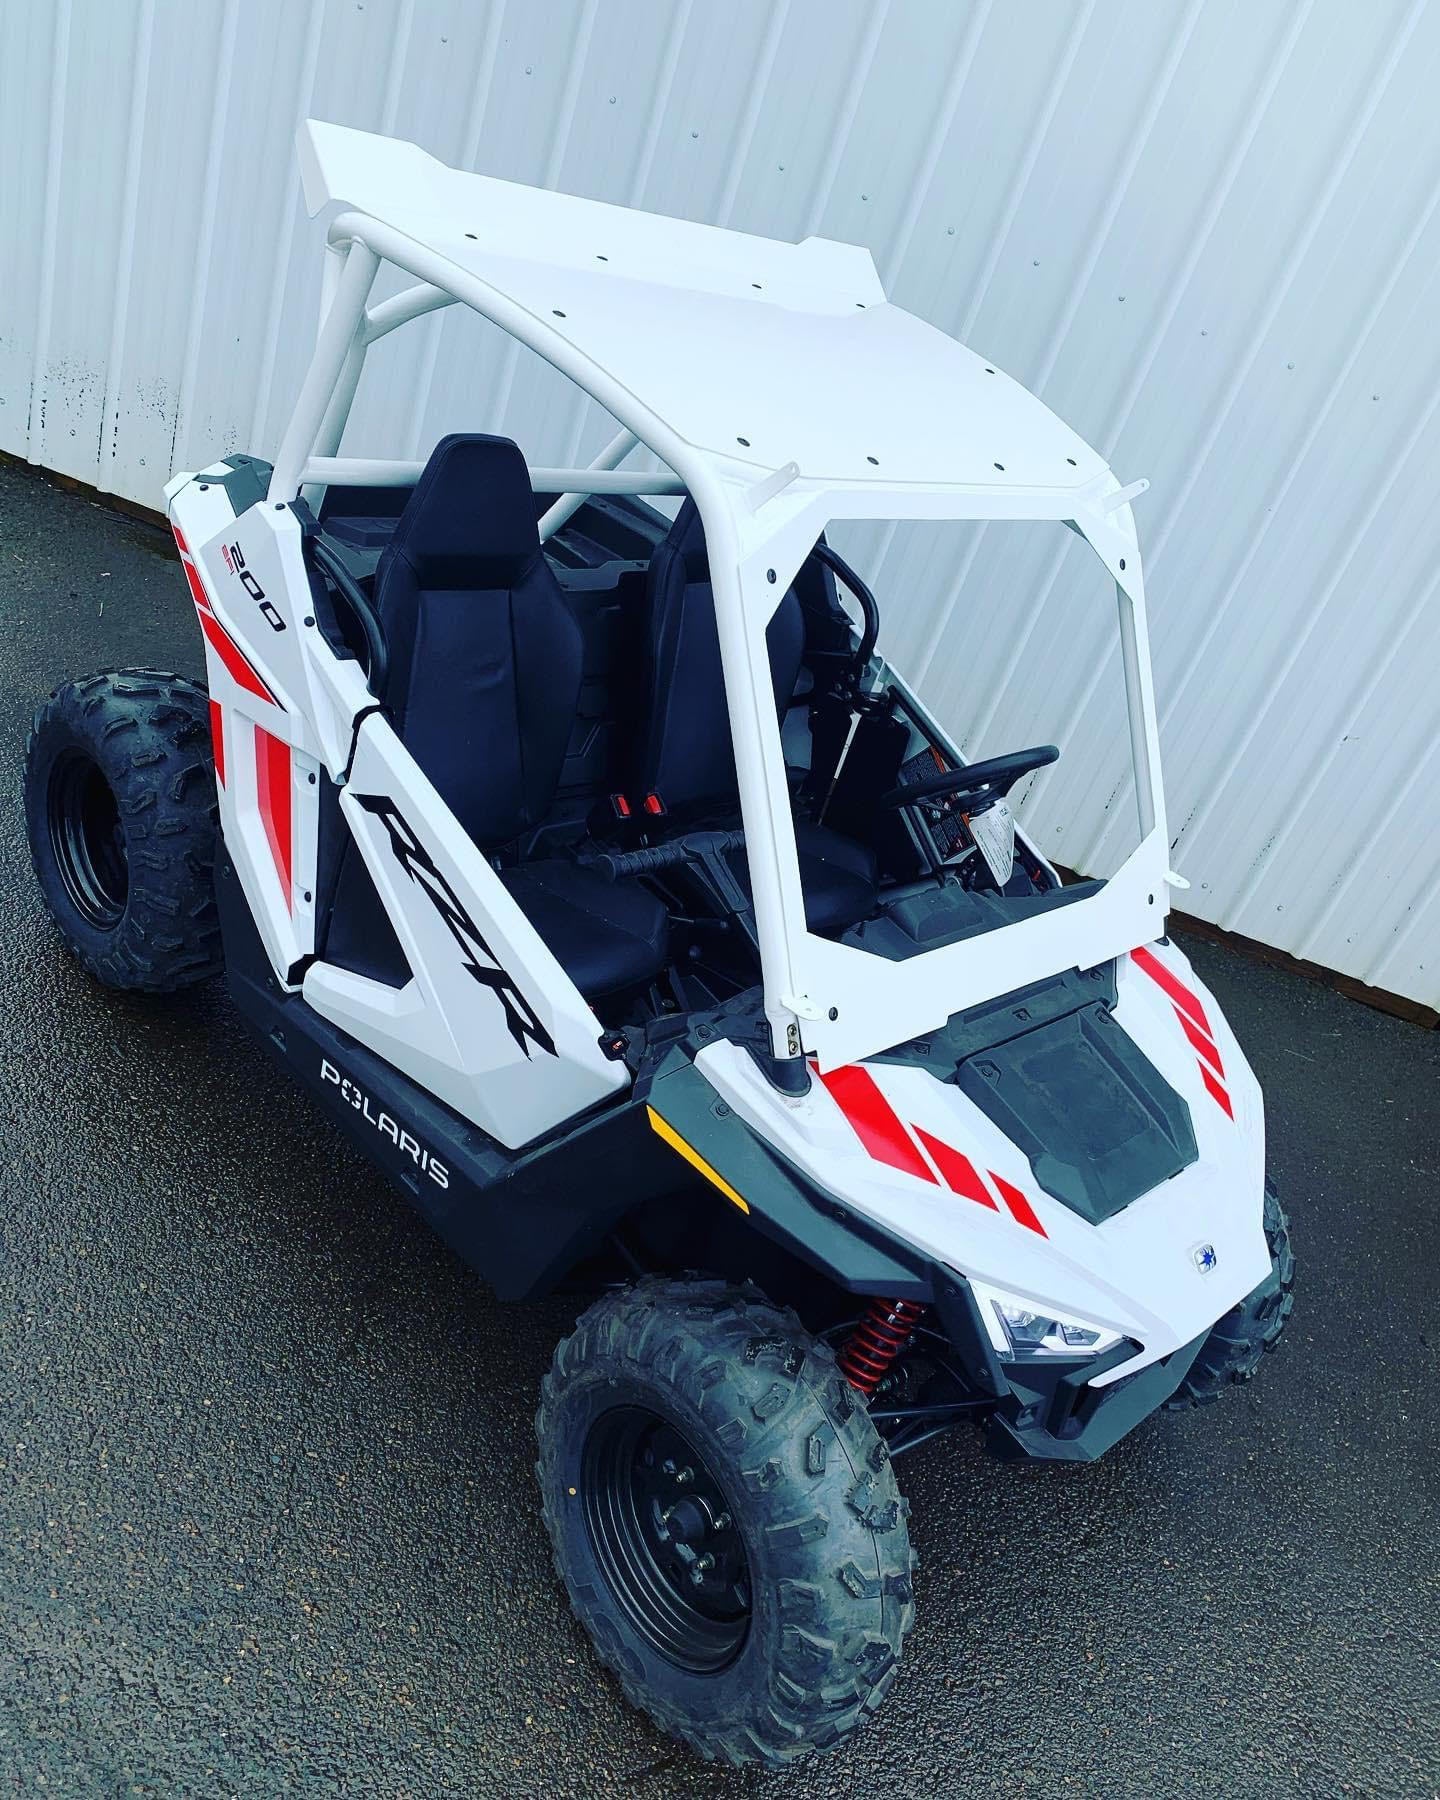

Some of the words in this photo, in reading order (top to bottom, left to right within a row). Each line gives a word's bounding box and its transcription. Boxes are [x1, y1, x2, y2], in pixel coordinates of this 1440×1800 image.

[229, 541, 287, 632] 200
[349, 793, 559, 1062] RZR
[320, 1058, 449, 1189] POLARIS
